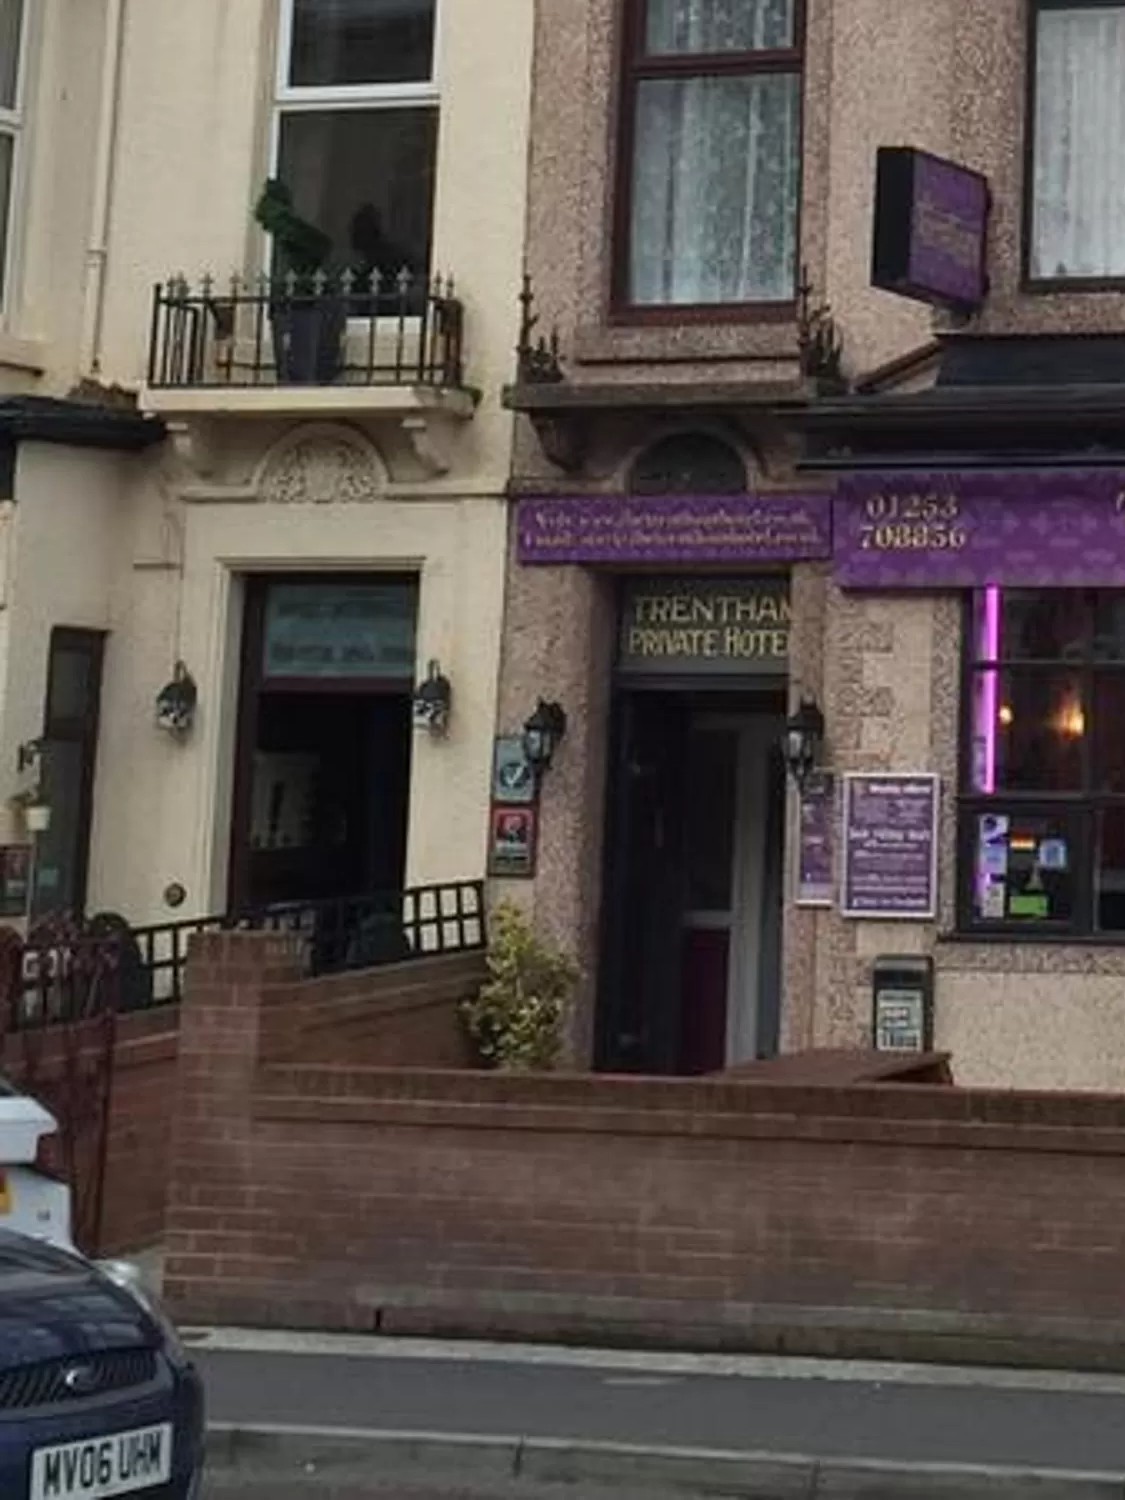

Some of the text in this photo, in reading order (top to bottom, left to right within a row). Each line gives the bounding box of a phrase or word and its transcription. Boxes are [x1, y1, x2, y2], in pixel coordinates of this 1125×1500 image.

[866, 493, 959, 519] 01253
[859, 522, 967, 549] 708856
[629, 626, 789, 657] PRIVATE HOTE
[43, 1443, 112, 1497] MV06
